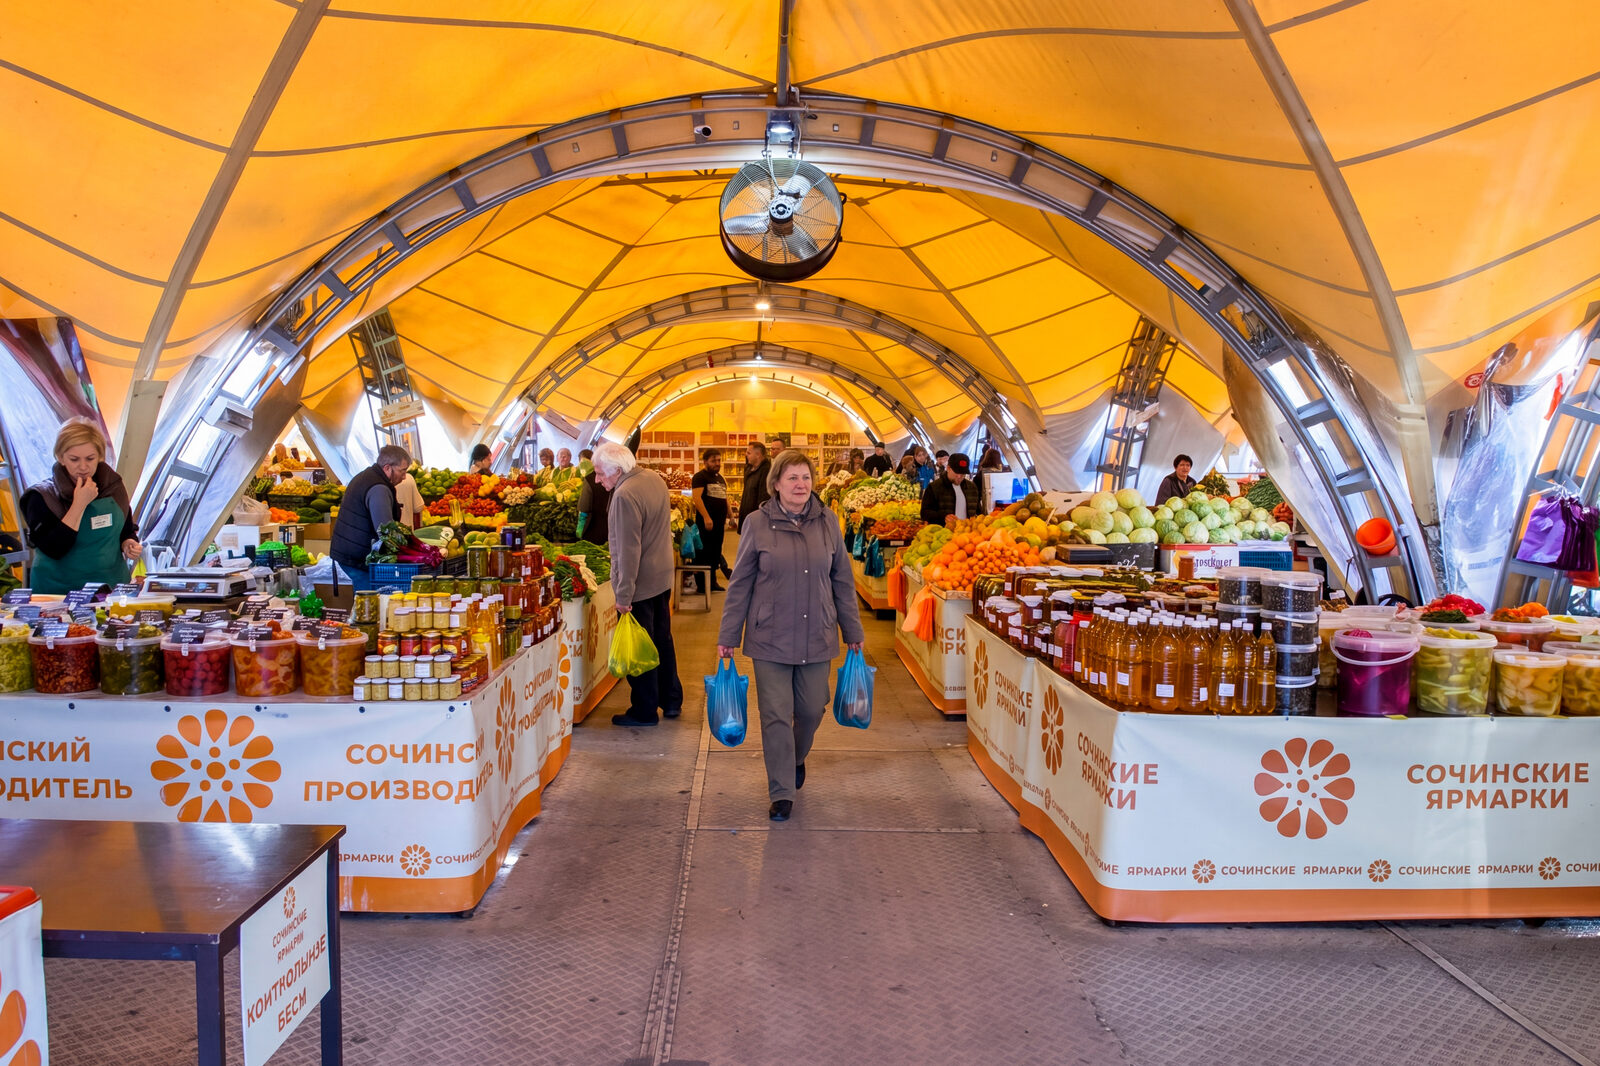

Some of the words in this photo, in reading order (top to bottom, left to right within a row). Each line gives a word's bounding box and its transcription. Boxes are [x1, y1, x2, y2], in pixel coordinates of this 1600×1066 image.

[0, 736, 90, 762] СКИЙ
[1077, 731, 1159, 785] СОЧИНСКИЕ
[1407, 762, 1589, 785] СОЧИНСКИЕ
[1081, 760, 1137, 811] ЯРМАРКИ
[1426, 788, 1569, 809] ЯРМАРКИ
[1127, 866, 1187, 876] ЯРМАРКИ
[1221, 865, 1296, 876] СОЧИНСКИЕ
[1303, 865, 1363, 875] ЯРМАРКИ
[1398, 865, 1471, 876] СОЧИНСКИЕ
[1477, 863, 1534, 874] ЯРМАРКИ
[1565, 863, 1600, 873] СОЧИ
